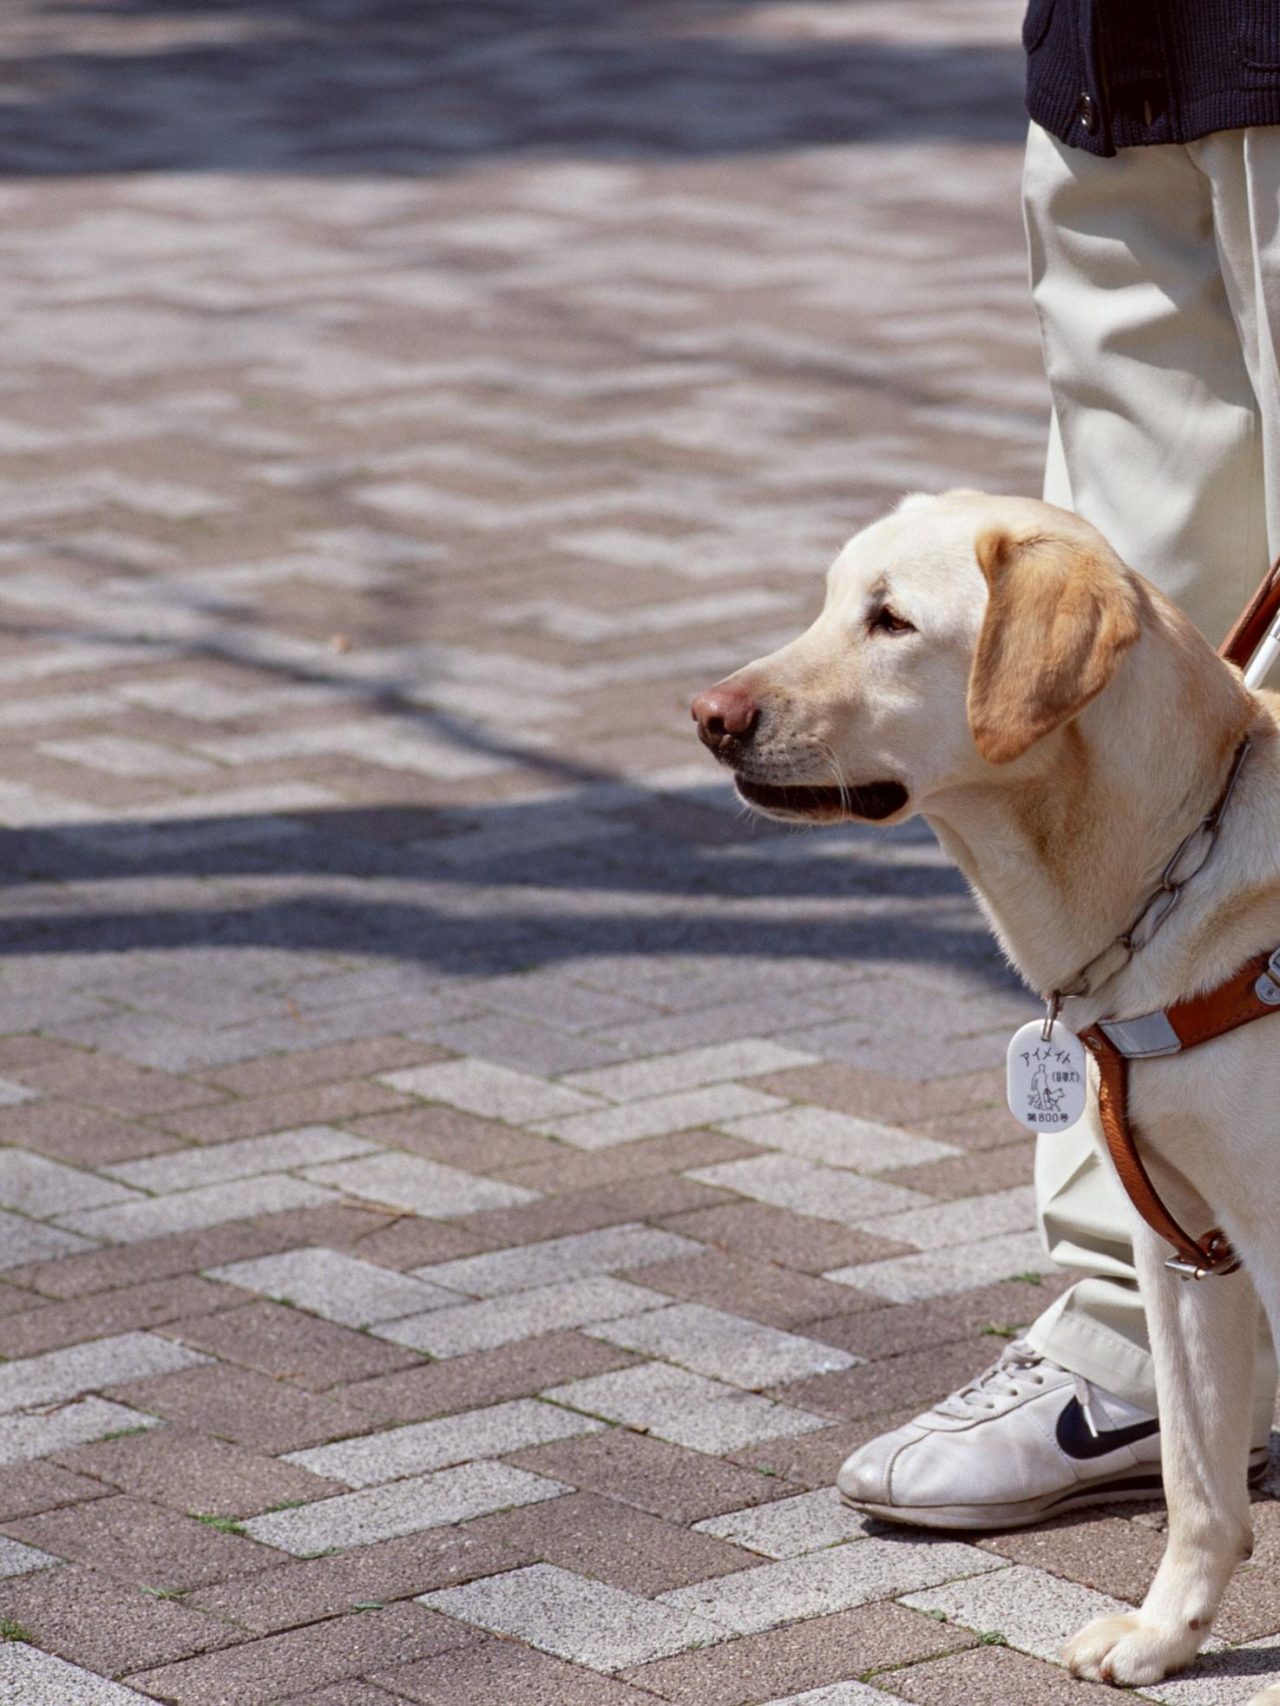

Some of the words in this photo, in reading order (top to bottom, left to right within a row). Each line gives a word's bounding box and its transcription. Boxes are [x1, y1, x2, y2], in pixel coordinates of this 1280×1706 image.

[1020, 1047, 1071, 1067] アイメイト
